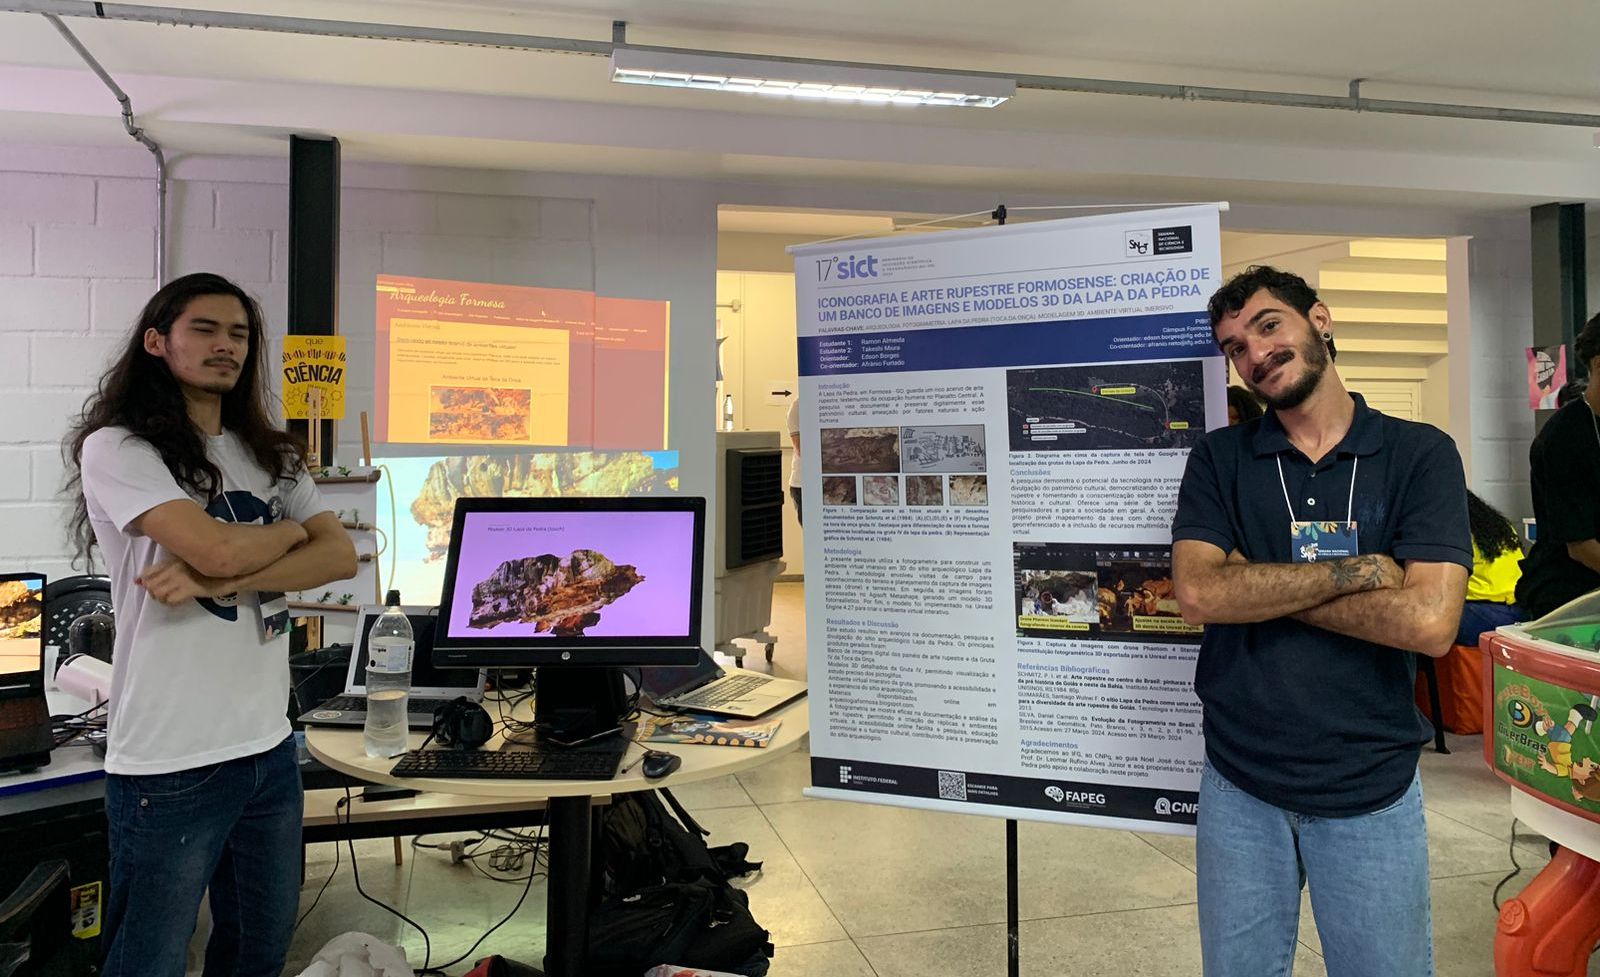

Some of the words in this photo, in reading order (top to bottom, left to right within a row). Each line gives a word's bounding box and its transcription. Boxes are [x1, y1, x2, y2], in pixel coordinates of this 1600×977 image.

[837, 255, 878, 279] sict
[818, 293, 898, 308] ICONOGRAFIA
[901, 291, 908, 302] E
[912, 289, 943, 301] ARTE
[947, 283, 1014, 299] RUPESTRE
[1018, 275, 1116, 293] FORMOSENSE:
[1121, 268, 1186, 286] CRIAÇÃO
[1191, 268, 1210, 280] DE
[460, 293, 506, 309] Formosa
[819, 310, 836, 321] UM
[840, 308, 881, 320] BANCO
[885, 306, 900, 318] DE
[903, 302, 960, 316] IMAGENS
[963, 301, 970, 311] E
[974, 296, 1038, 311] MODELOS
[1042, 295, 1059, 307] 3D
[1063, 293, 1082, 305] DA
[1086, 290, 1124, 303] LAPA
[1128, 288, 1148, 301] DA
[1152, 284, 1200, 299] PEDRA
[305, 338, 324, 346] que
[284, 362, 343, 384] CIÊNCIA
[1016, 477, 1041, 485] pesquisa
[1081, 477, 1108, 485] potencial
[1035, 514, 1051, 522] prevê
[824, 548, 861, 556] Metodologia
[826, 618, 860, 626] Resultados
[866, 620, 898, 628] Discussão
[1017, 663, 1058, 672] Referências
[1060, 665, 1109, 675] Bibliográficas
[1020, 739, 1077, 749] Agradecimentos
[1021, 747, 1058, 756] Agradecemos
[1073, 766, 1108, 775] colaboração
[1066, 791, 1106, 804] FAPEG
[1172, 801, 1200, 814] CNP
